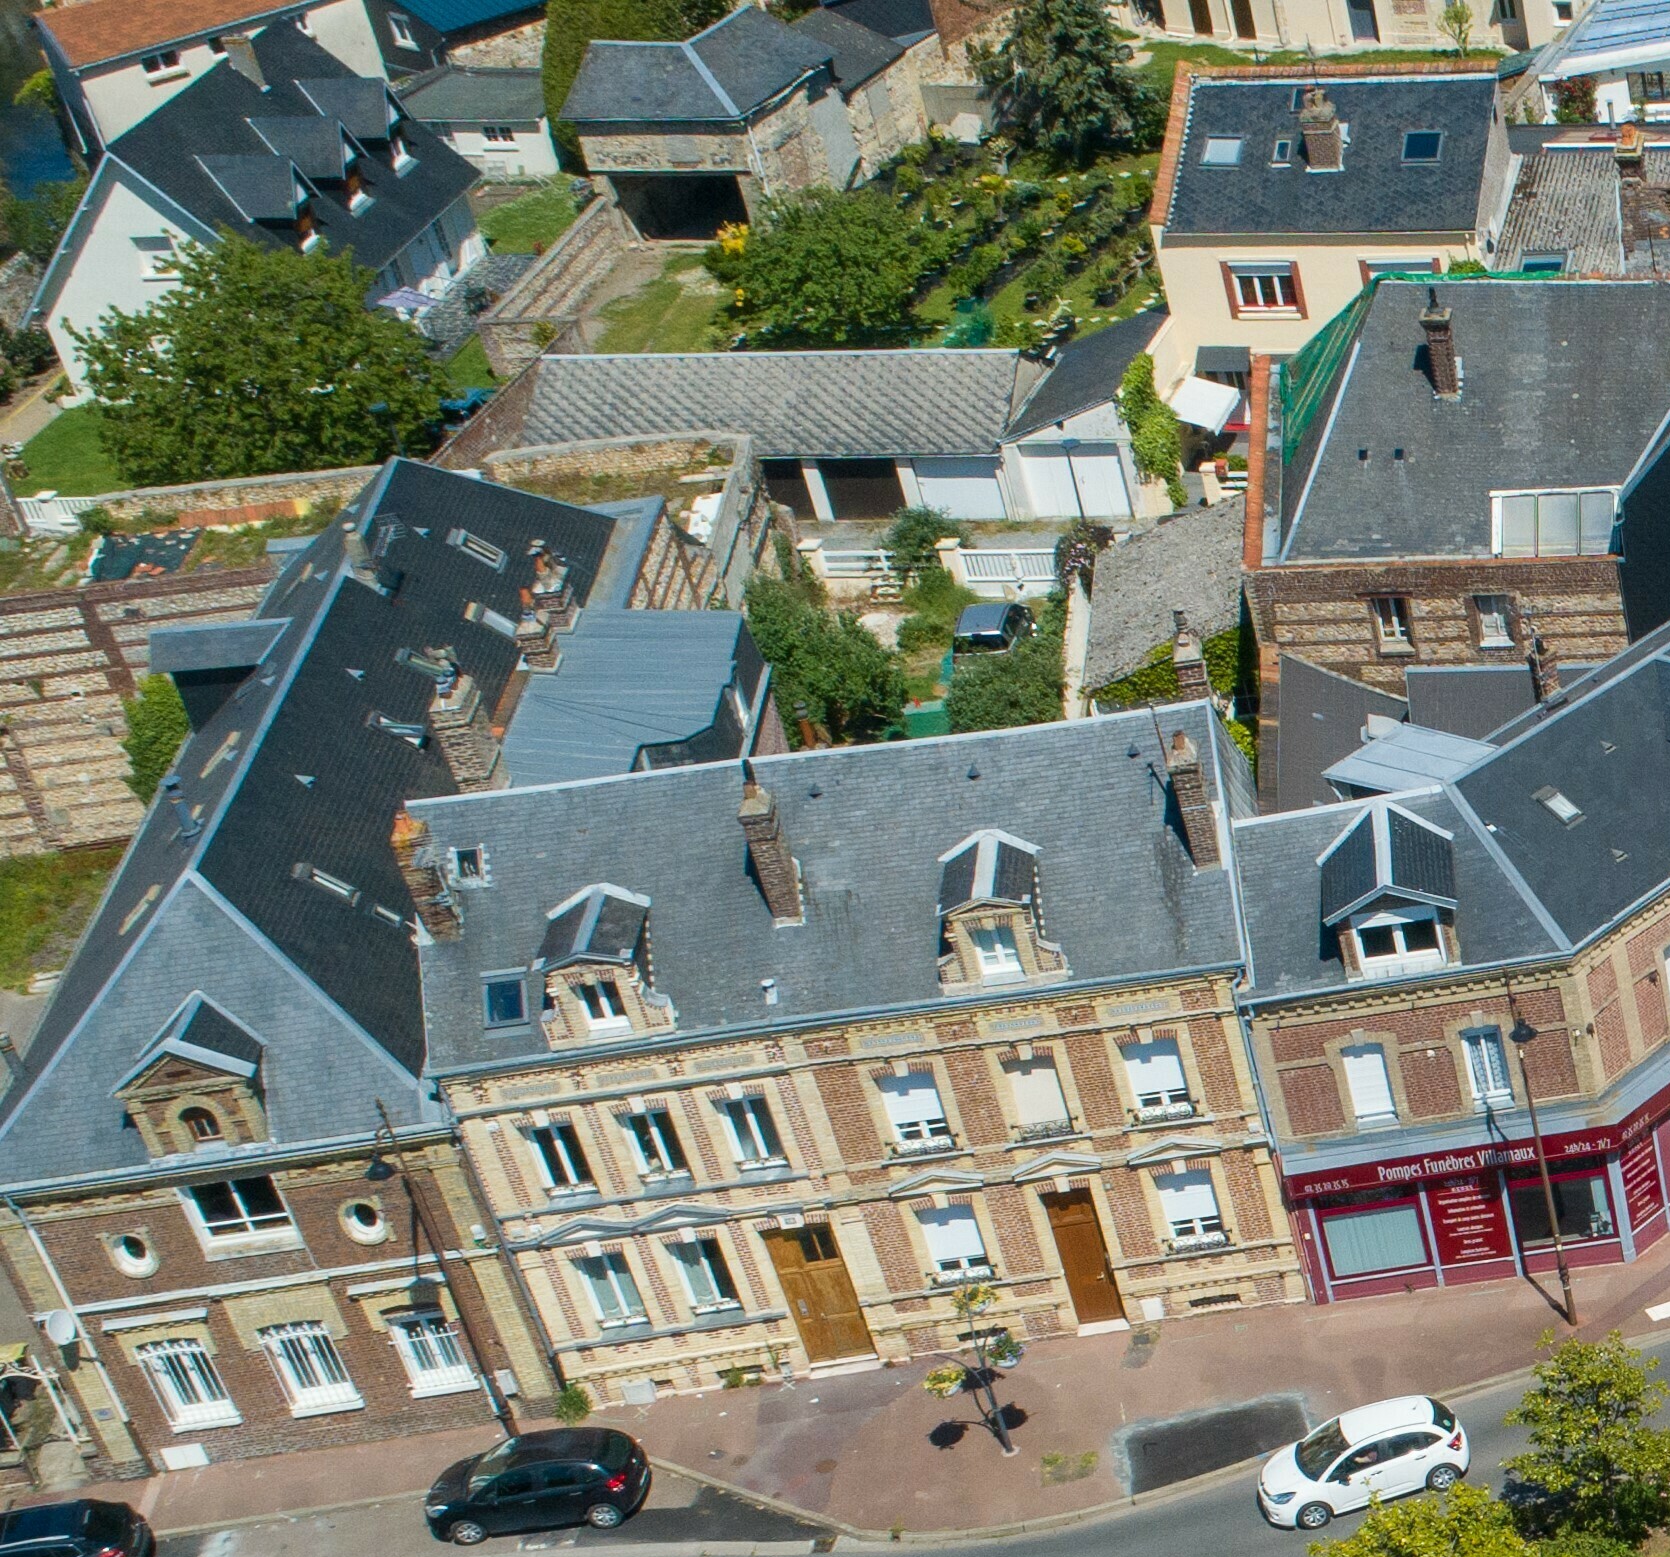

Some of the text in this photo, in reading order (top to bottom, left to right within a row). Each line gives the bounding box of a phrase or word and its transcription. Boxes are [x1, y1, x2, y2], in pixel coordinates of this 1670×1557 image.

[1377, 1146, 1535, 1181] Pompes Funèbres Villamaux
